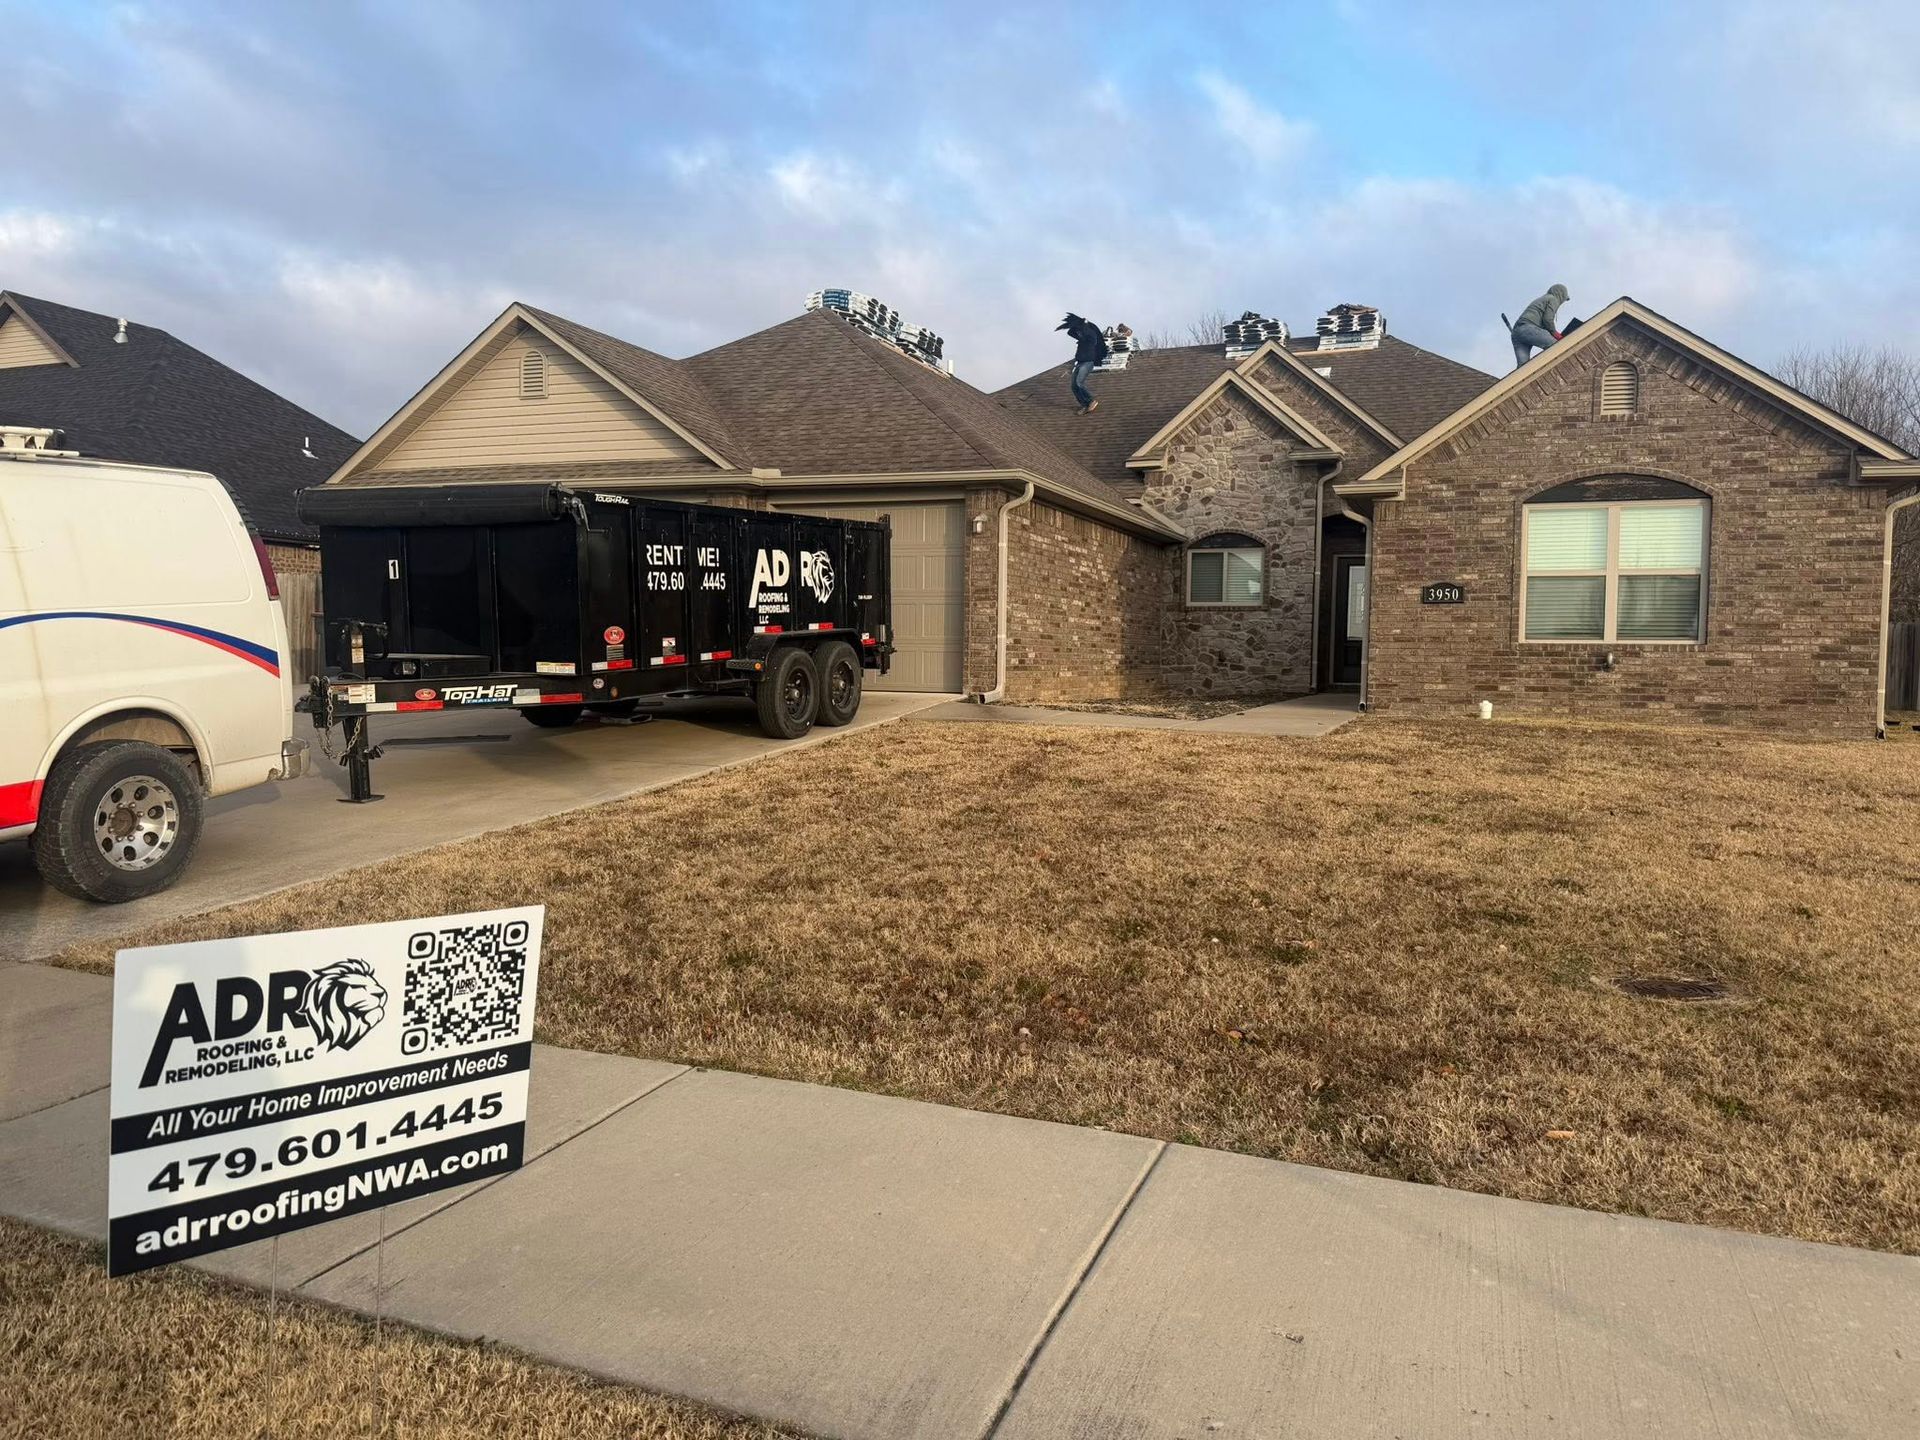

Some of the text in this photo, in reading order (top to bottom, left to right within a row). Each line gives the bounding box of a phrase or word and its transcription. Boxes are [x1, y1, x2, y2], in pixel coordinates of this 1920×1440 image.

[646, 544, 720, 567] RENT ME!
[391, 561, 397, 578] 1
[748, 549, 813, 609] ADR
[758, 592, 784, 602] ROOFING
[1428, 588, 1459, 601] 3950
[758, 604, 790, 614] REMODELING
[759, 615, 769, 624] LLC
[138, 970, 312, 1089] ADR
[197, 1035, 287, 1062] ROOFING &
[165, 1047, 314, 1084] REMODELING, LLC
[147, 1051, 508, 1139] All Your Home Improvement Needs
[148, 1091, 503, 1193] 479.601.4445
[135, 1142, 508, 1255] adrroofingNWA.com
